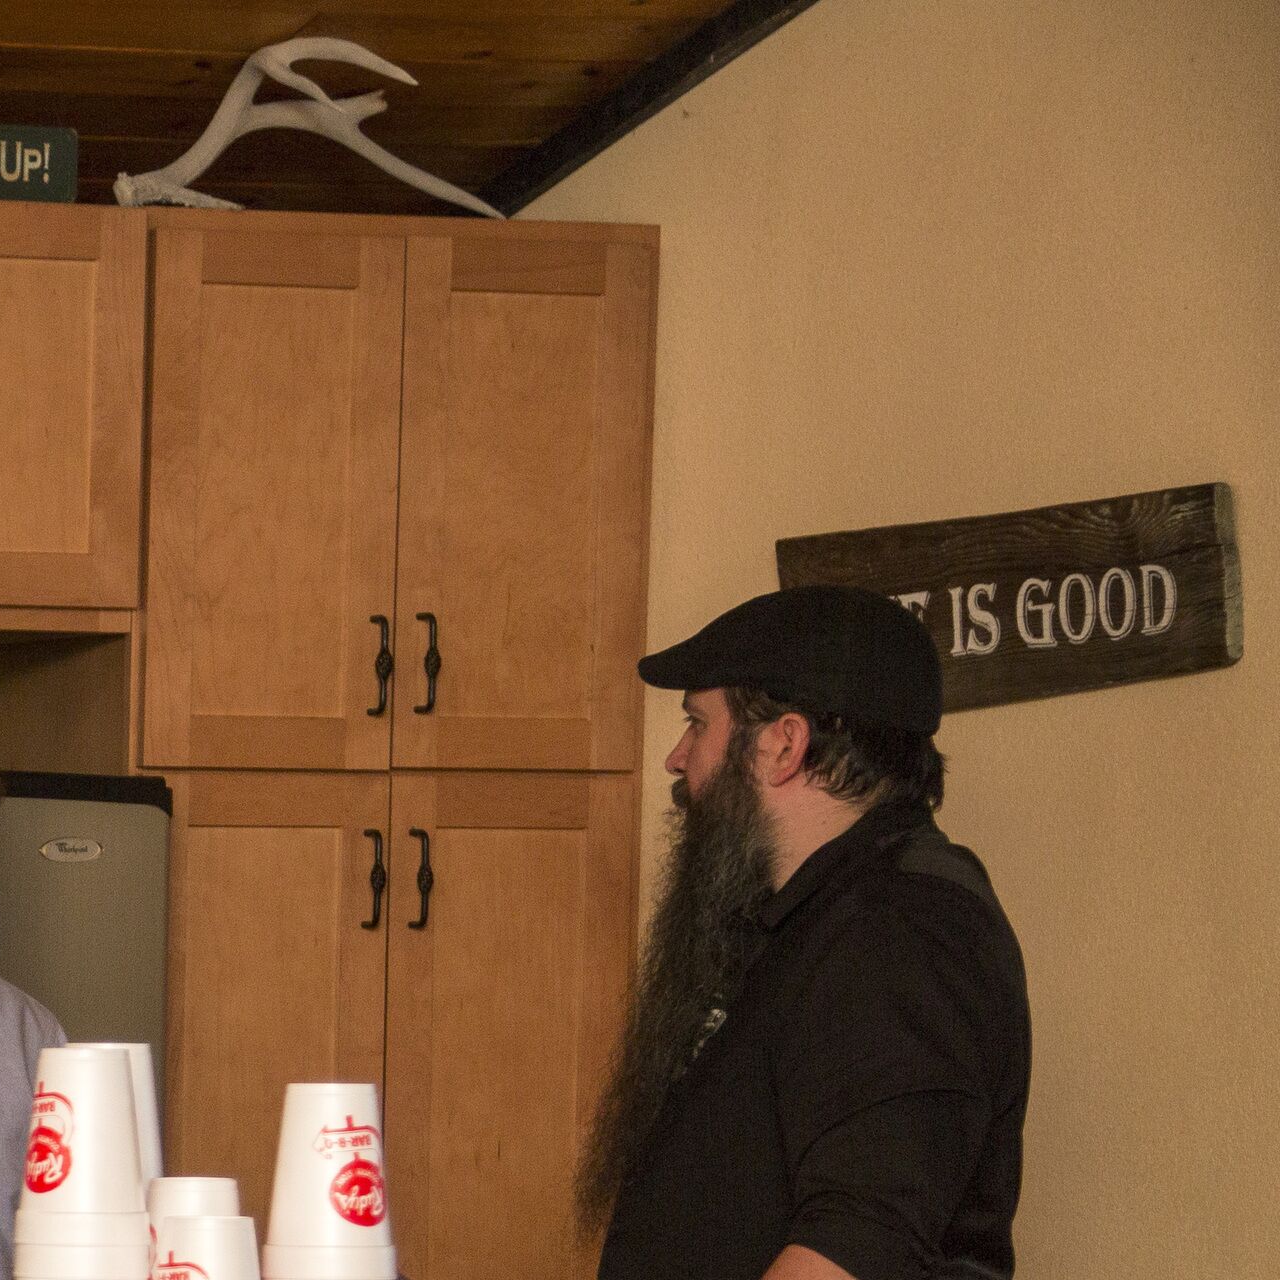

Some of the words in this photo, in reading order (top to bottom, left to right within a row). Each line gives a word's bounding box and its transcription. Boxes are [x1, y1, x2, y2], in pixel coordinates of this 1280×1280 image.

[0, 139, 51, 185] UP!
[948, 582, 1001, 657] IS
[1016, 564, 1177, 648] GOOD
